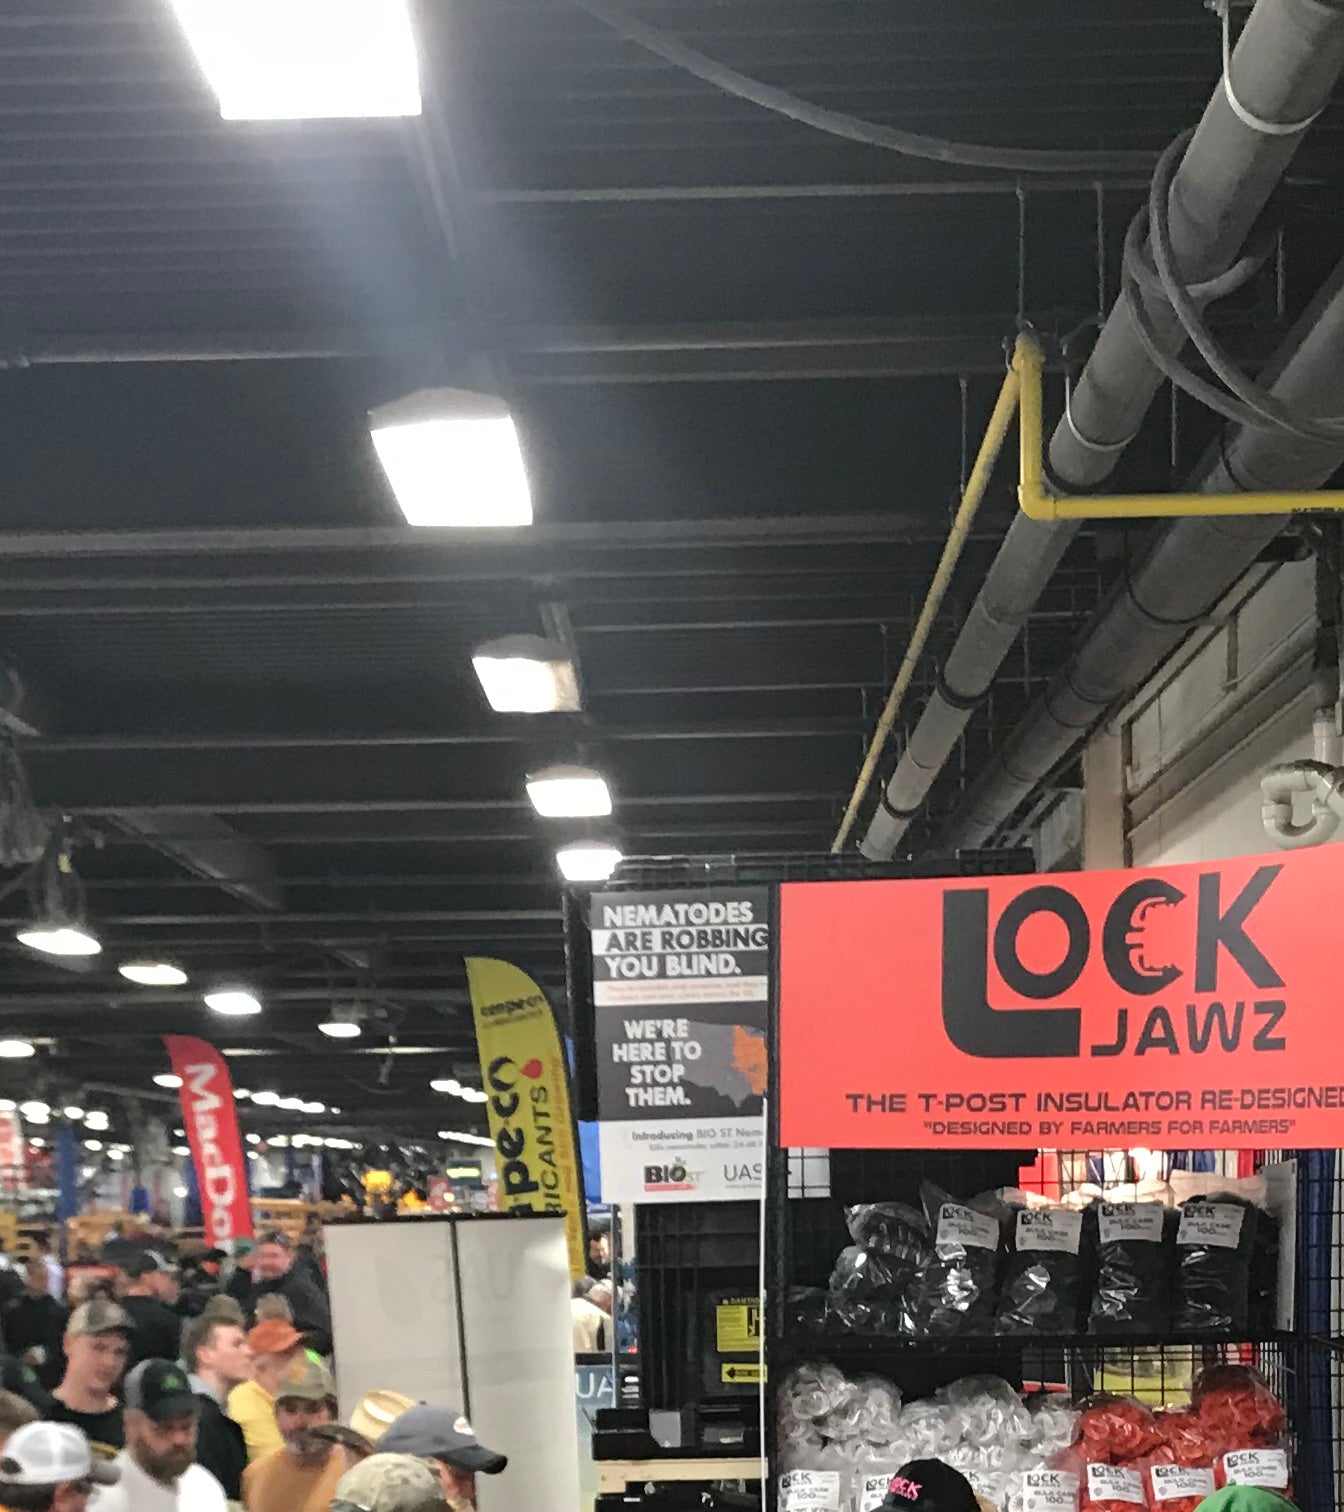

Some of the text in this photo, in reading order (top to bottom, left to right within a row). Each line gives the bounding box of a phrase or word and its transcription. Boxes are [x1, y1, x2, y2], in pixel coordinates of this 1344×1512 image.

[603, 901, 754, 928] NEMATODES
[606, 926, 768, 952] ARE ROBBING
[605, 953, 741, 977] YOU BLIND.
[942, 864, 1286, 1058] LOCK
[624, 1018, 689, 1040] WE'RE
[1091, 999, 1287, 1058] JAWZ
[612, 1041, 702, 1063] HERE TO
[630, 1064, 685, 1084] STOP
[625, 1086, 691, 1107] THEM.
[845, 1094, 906, 1113] THE
[918, 1092, 1024, 1113] T-POST
[1038, 1090, 1190, 1112] INSULATOR
[632, 1130, 693, 1141] Introducing
[1040, 1120, 1063, 1135] BY
[1071, 1120, 1162, 1135] FARMERS
[1168, 1119, 1203, 1134] FOR
[644, 1164, 687, 1183] BIO
[1227, 1452, 1259, 1468] LOCK
[1027, 1473, 1060, 1487] LOCK
